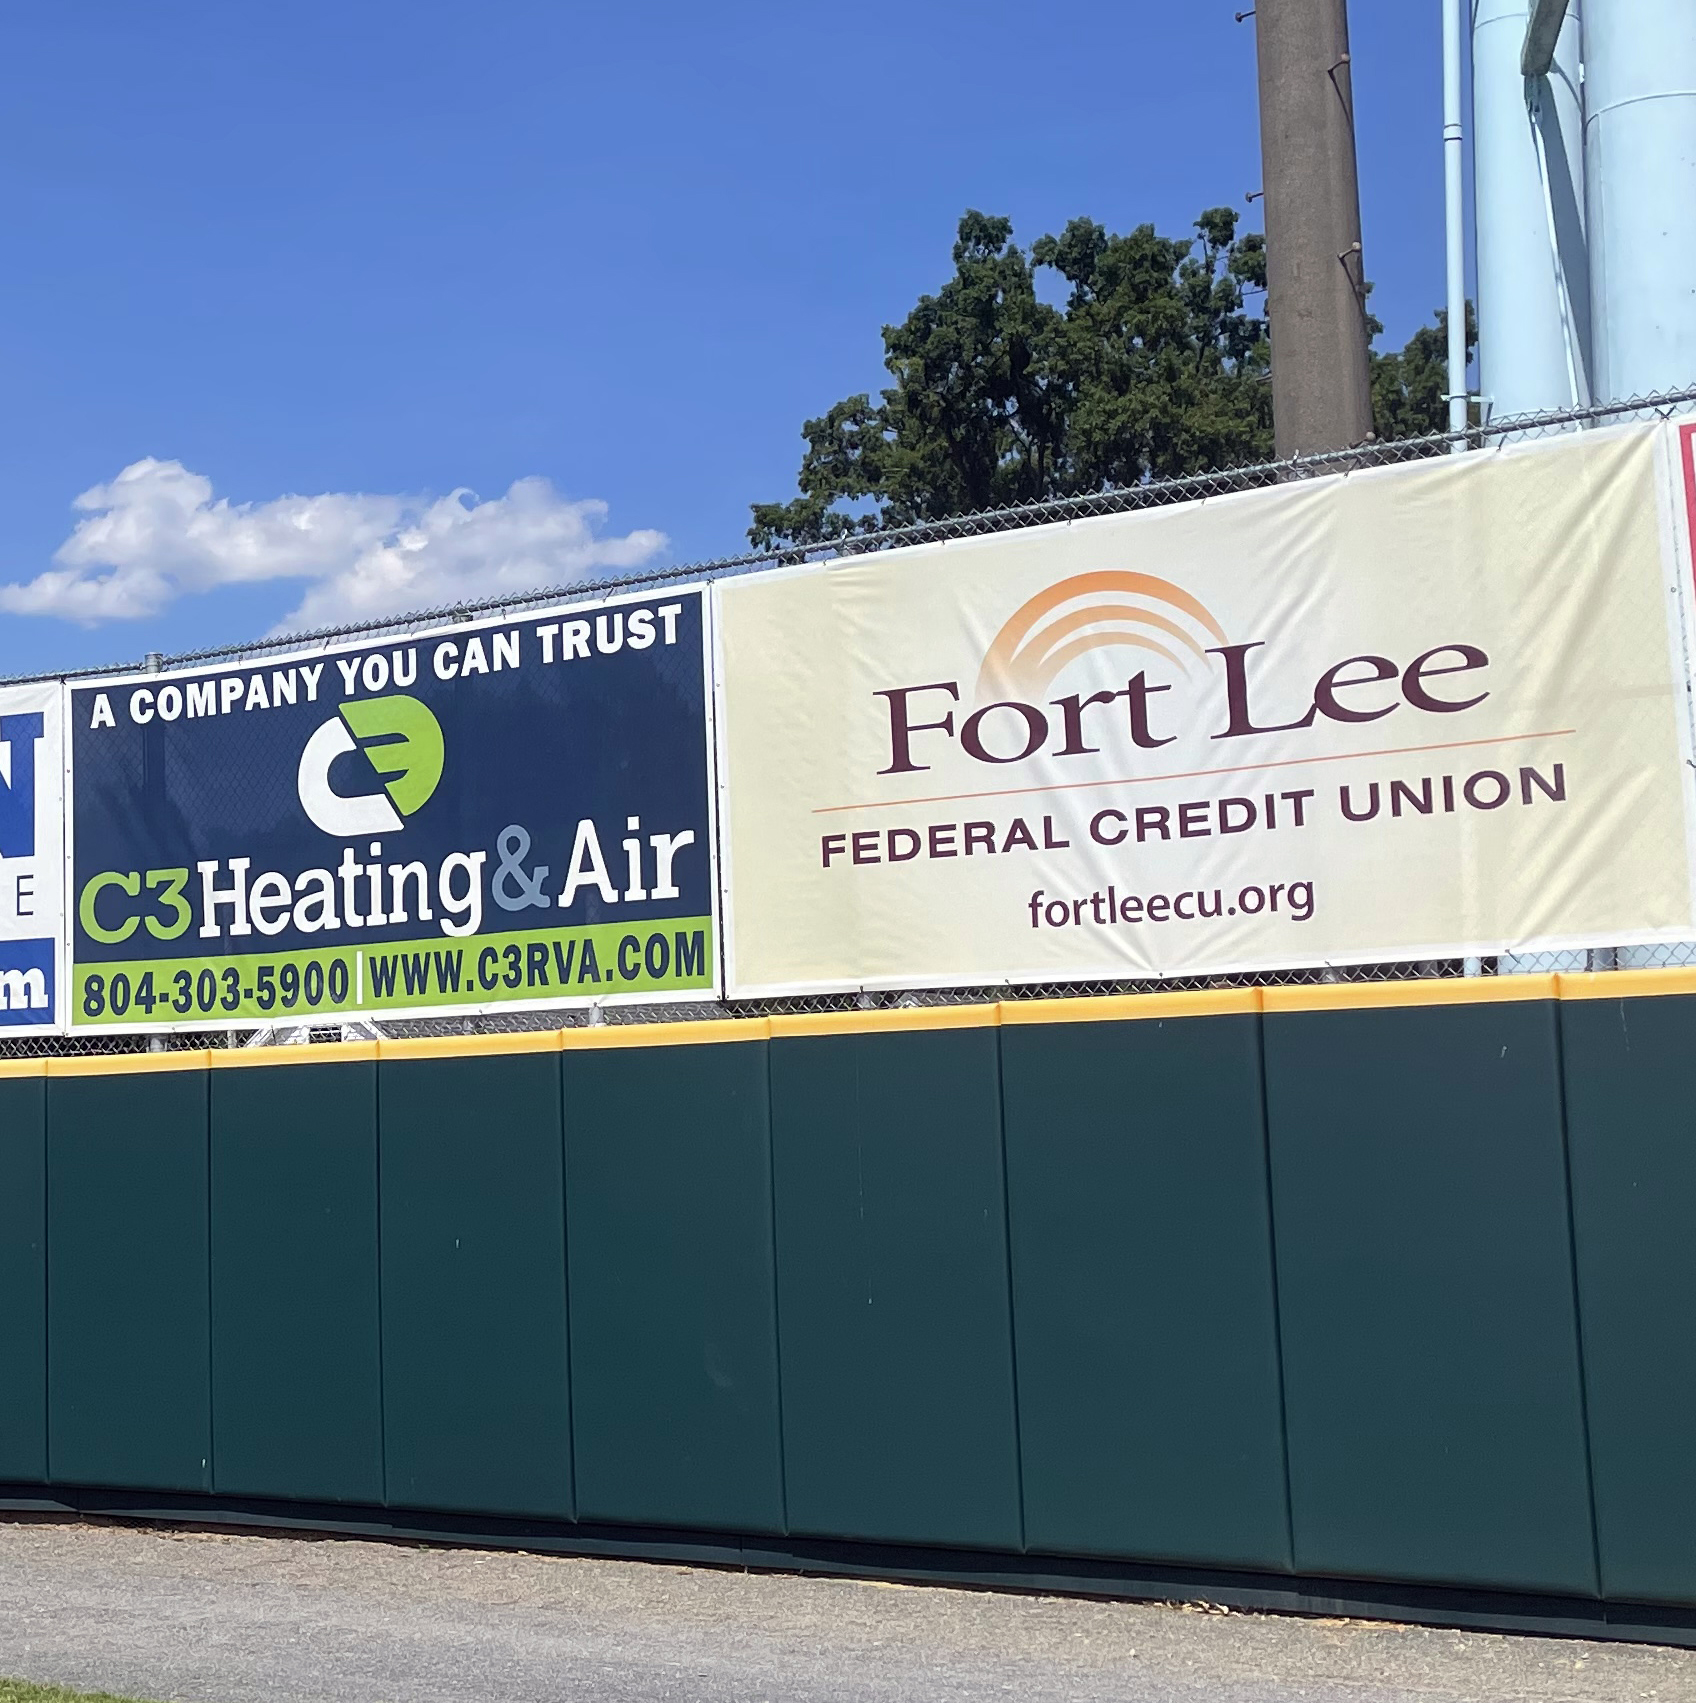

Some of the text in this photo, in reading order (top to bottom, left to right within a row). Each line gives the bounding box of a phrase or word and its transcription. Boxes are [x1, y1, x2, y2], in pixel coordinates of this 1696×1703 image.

[90, 604, 683, 729] A COMPANY YOU CAN TRUST
[872, 641, 1491, 775] Fort Lee
[821, 763, 1567, 868] FEDERAL CREDIT UNION
[1028, 881, 1315, 929] fortleecu.org
[83, 930, 705, 1016] 804-303-5900 WWW.C3RVA.COM
